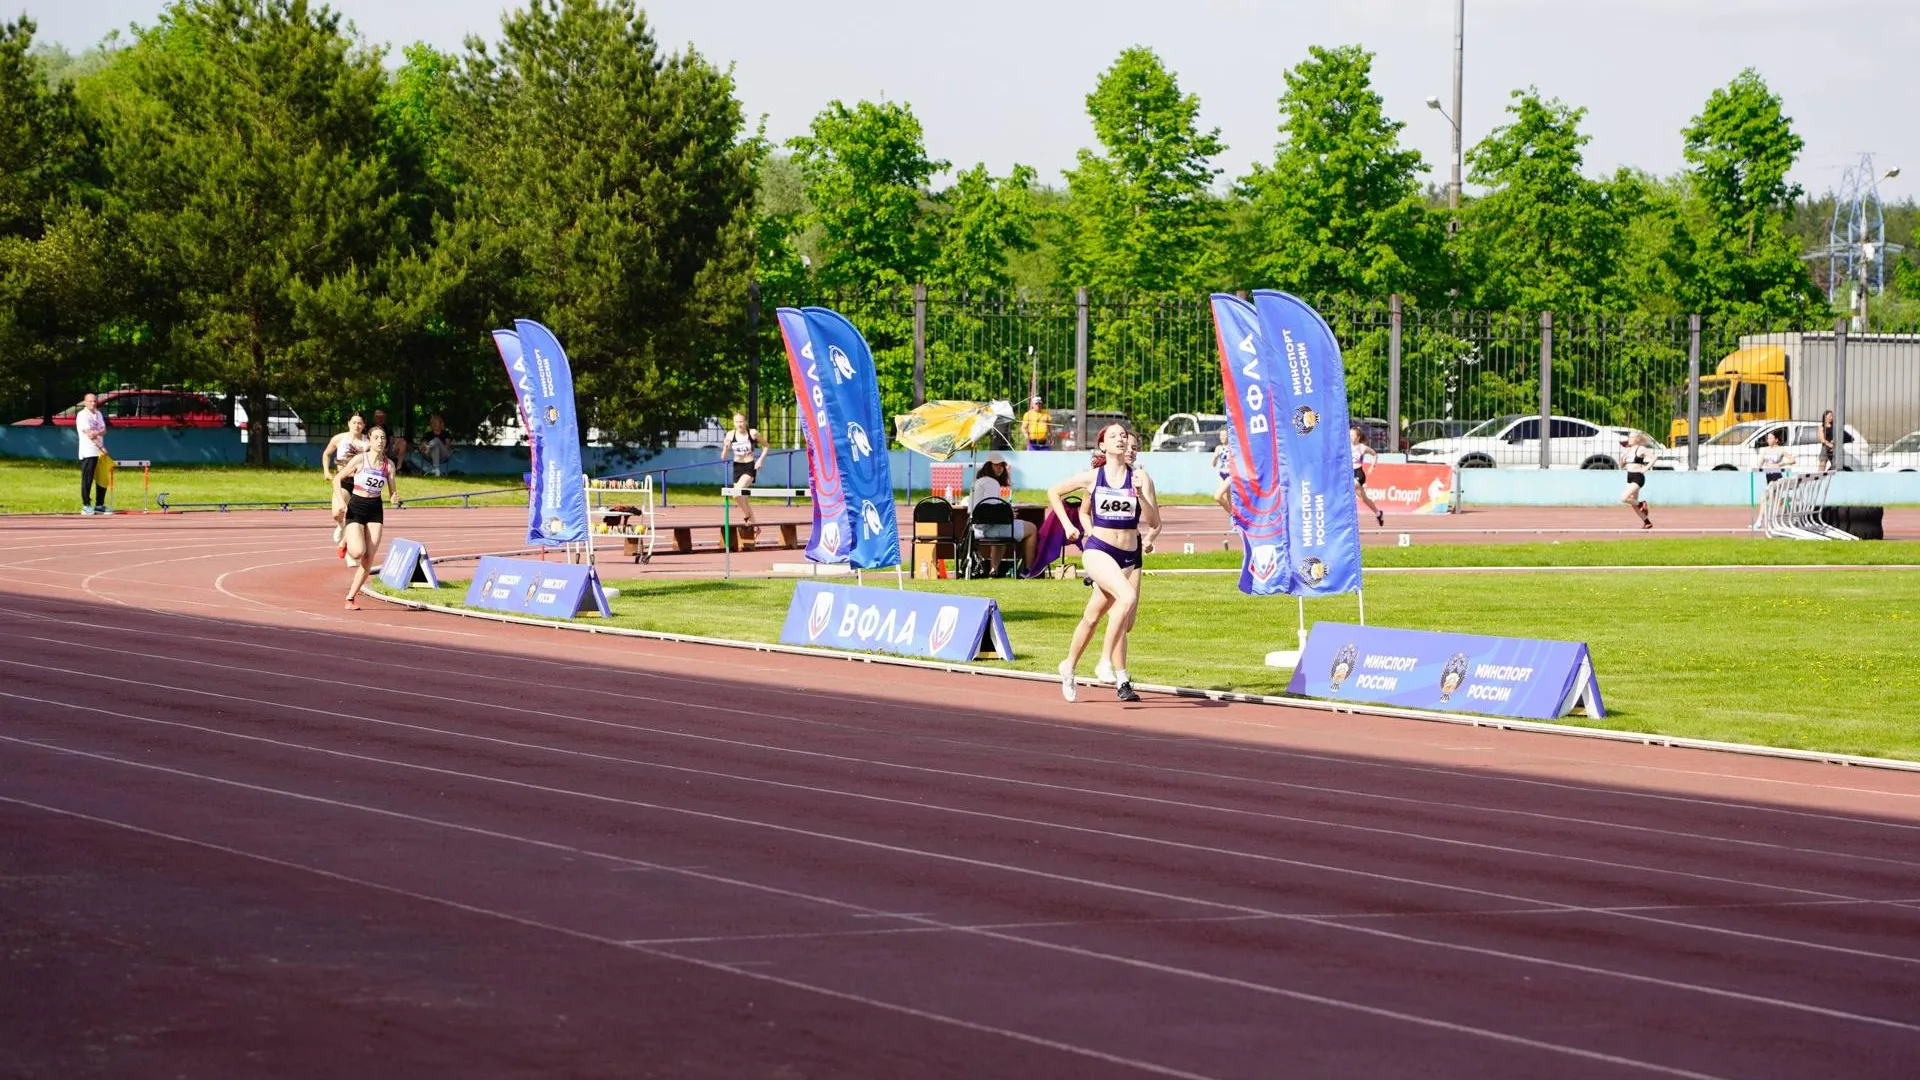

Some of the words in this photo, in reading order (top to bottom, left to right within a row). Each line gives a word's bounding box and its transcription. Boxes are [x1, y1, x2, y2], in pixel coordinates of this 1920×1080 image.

[534, 348, 549, 398] МИНСПОРТ
[801, 341, 827, 428] ВФЛА
[1239, 333, 1269, 434] ВФЛА
[1282, 329, 1303, 396] МИНСПОРТ
[1297, 342, 1314, 394] РОССИИ
[365, 477, 385, 489] 520
[1100, 499, 1131, 512] 482
[1302, 479, 1313, 548] МИНСПОРТ
[1315, 494, 1325, 546] РОССИИ
[837, 603, 917, 645] ВФЛА
[1355, 674, 1398, 692] РОССИИ
[1363, 654, 1418, 672] МИНСПОРТ
[1474, 664, 1533, 683] МИНСПОРТ
[1467, 684, 1512, 702] РОССИИ
